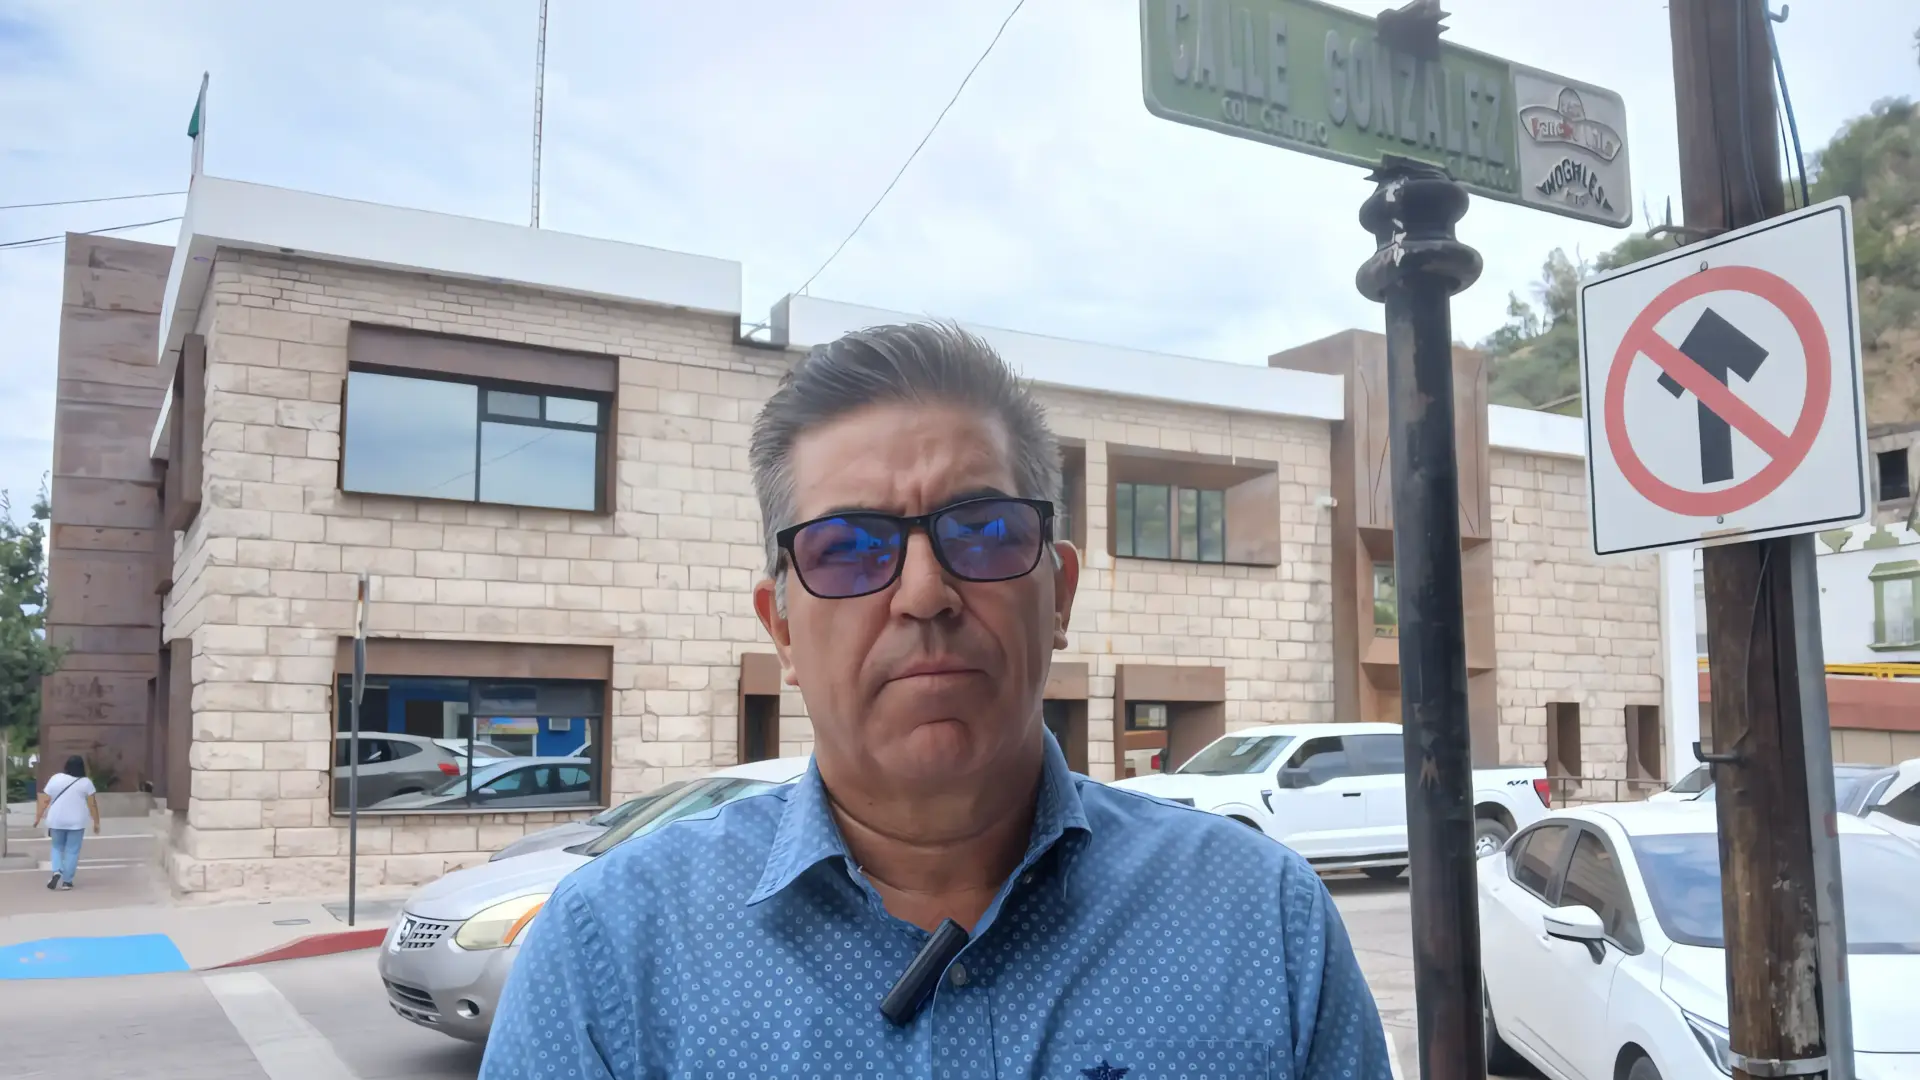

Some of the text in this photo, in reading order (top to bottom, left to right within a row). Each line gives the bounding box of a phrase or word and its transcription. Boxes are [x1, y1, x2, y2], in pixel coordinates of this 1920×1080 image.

[1166, 0, 1504, 163] CALLE GONZALEZ
[1542, 158, 1606, 205] NOGALES
